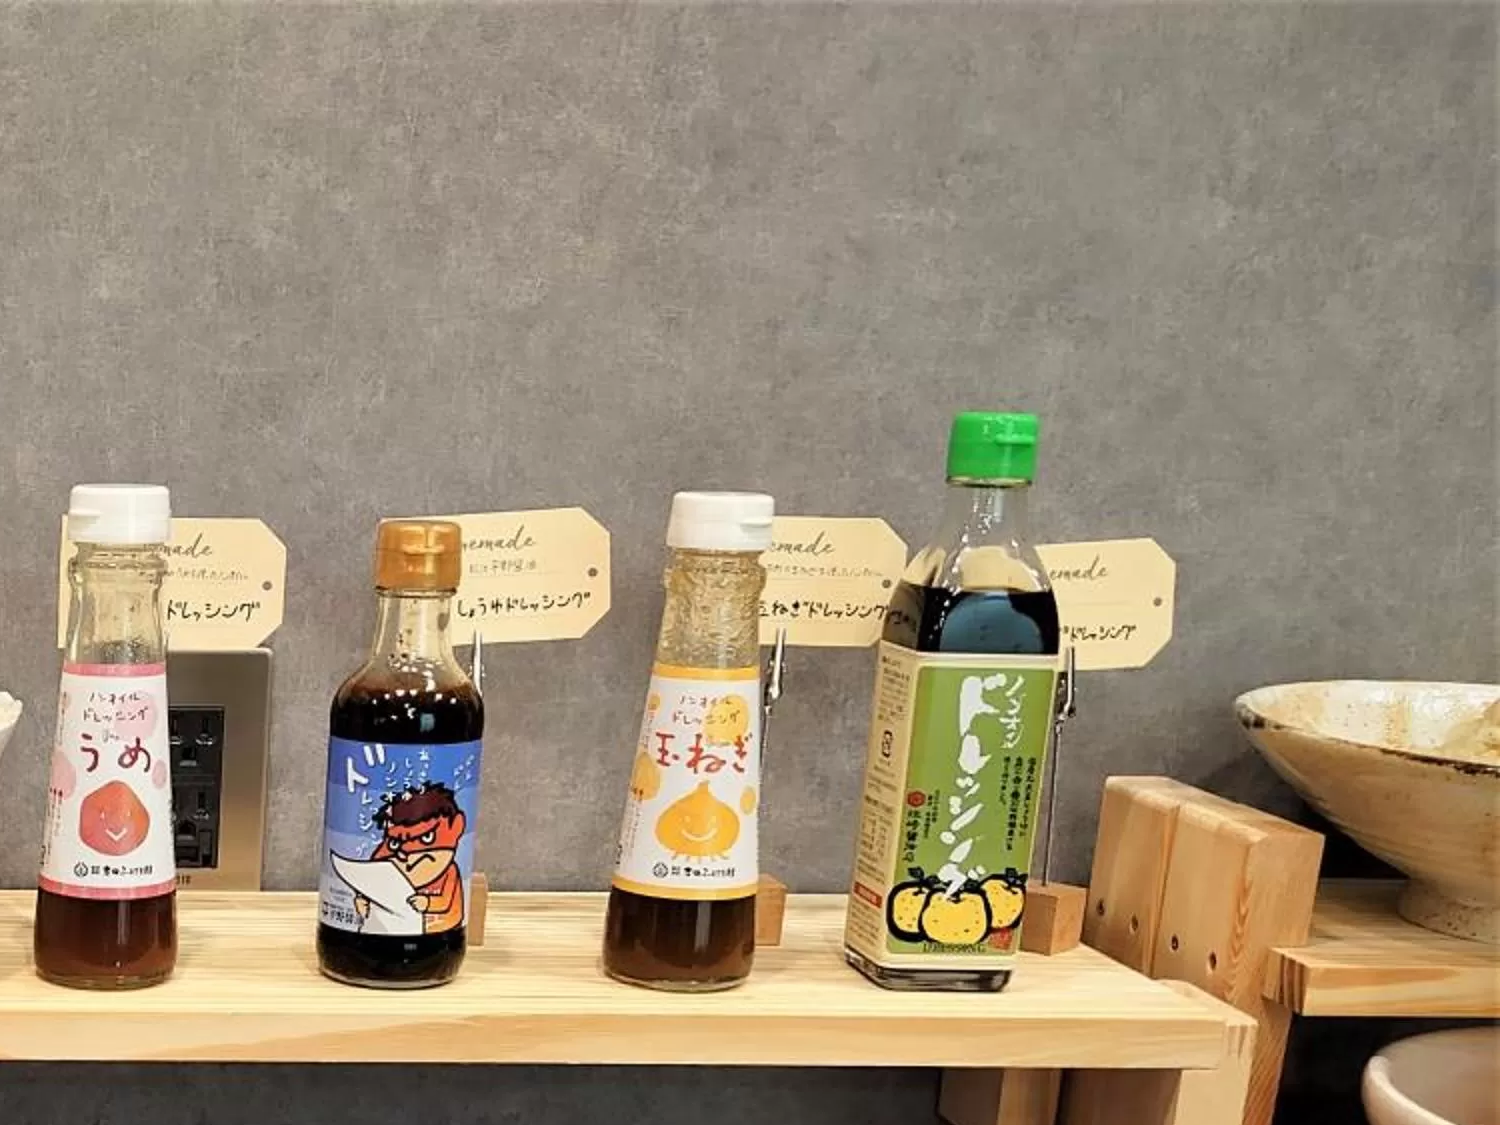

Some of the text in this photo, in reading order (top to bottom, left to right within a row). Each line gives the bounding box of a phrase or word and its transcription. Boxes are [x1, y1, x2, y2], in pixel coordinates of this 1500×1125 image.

[1063, 624, 1137, 642] ドレッシング
[80, 732, 152, 773] うめ
[655, 731, 753, 775] 玉ねぎ
